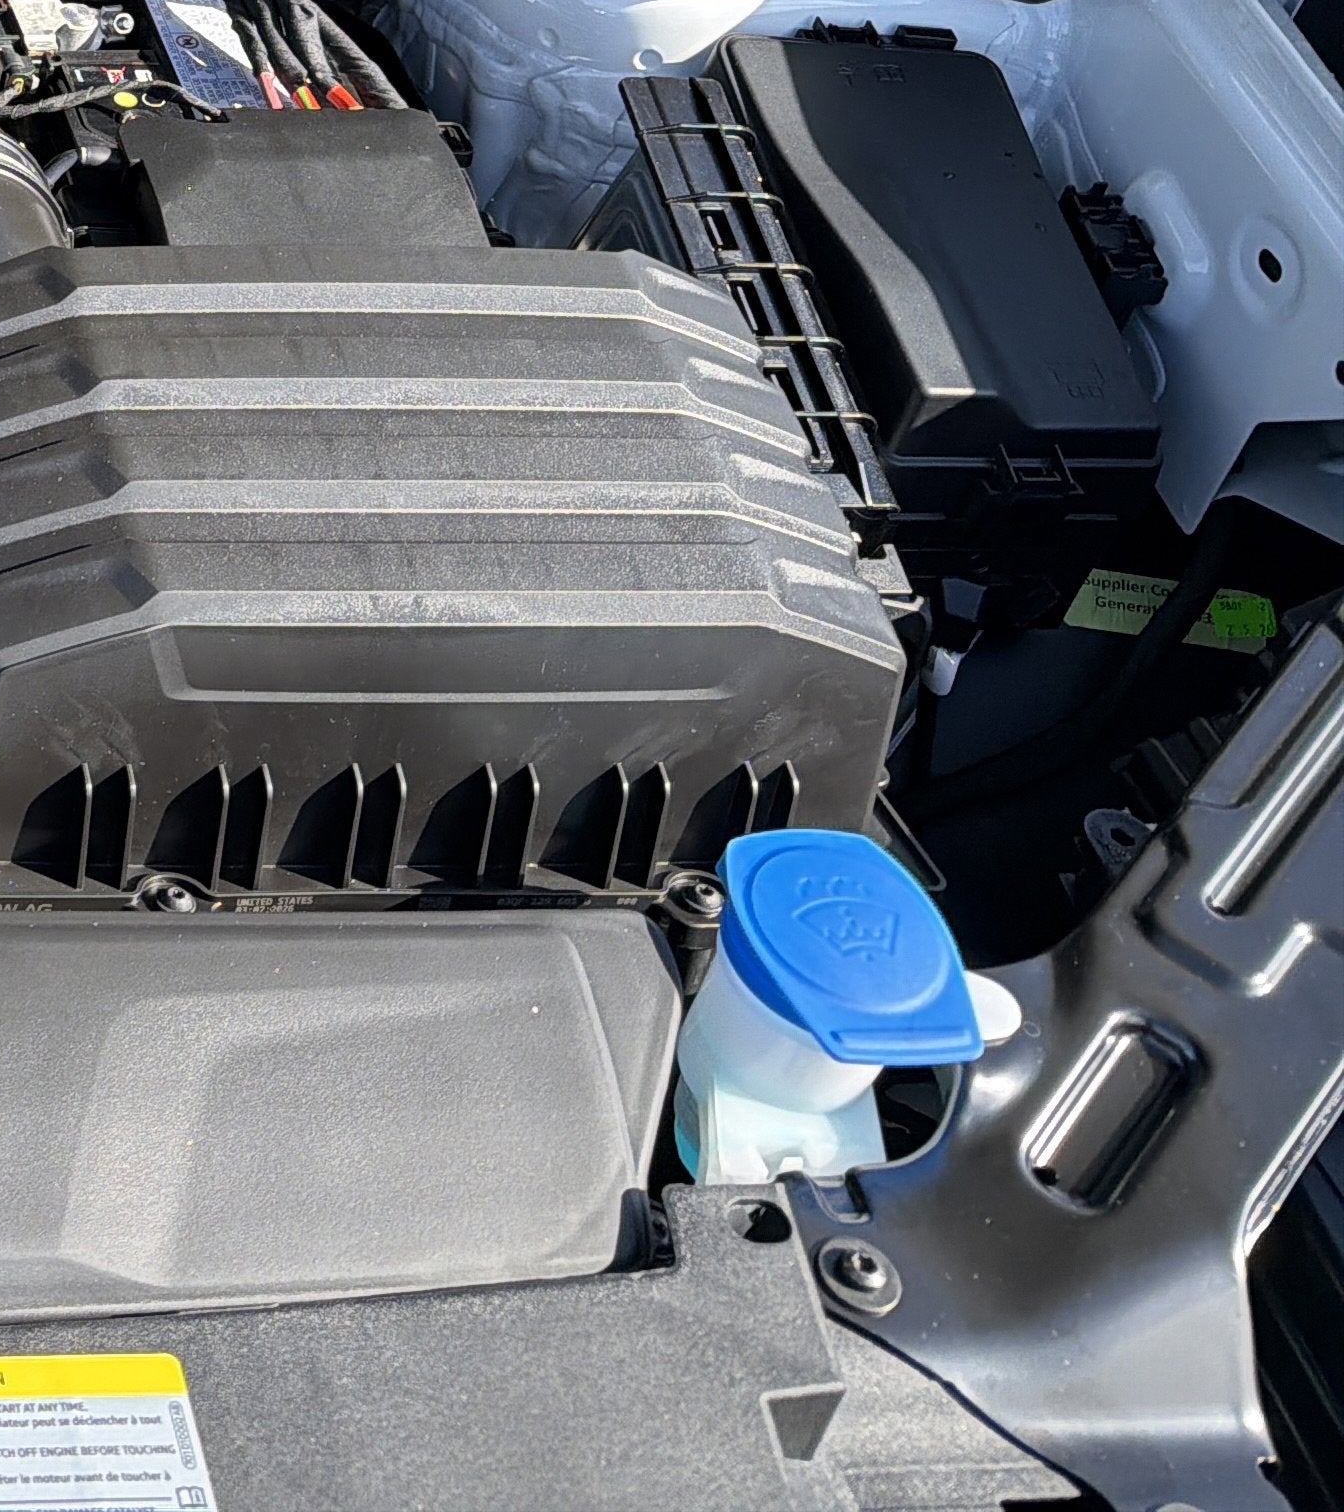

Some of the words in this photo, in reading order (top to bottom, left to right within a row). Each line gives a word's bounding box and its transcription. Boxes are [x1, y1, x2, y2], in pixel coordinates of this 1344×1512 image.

[237, 898, 273, 906] UNITED
[277, 896, 314, 905] STATES
[23, 1403, 35, 1412] AT
[38, 1402, 59, 1412] ANY
[32, 1418, 56, 1430] peut
[58, 1418, 70, 1426] se
[72, 1415, 128, 1426] déclencher
[139, 1415, 161, 1424] tout
[17, 1447, 37, 1457] OFF
[39, 1446, 78, 1457] ENGINE
[81, 1445, 120, 1456] BEFORE
[122, 1444, 176, 1455] TOUCHING
[20, 1474, 31, 1484] le
[32, 1474, 71, 1484] moteur
[74, 1473, 104, 1483] avant
[106, 1472, 119, 1482] de
[121, 1471, 162, 1481] toucher
